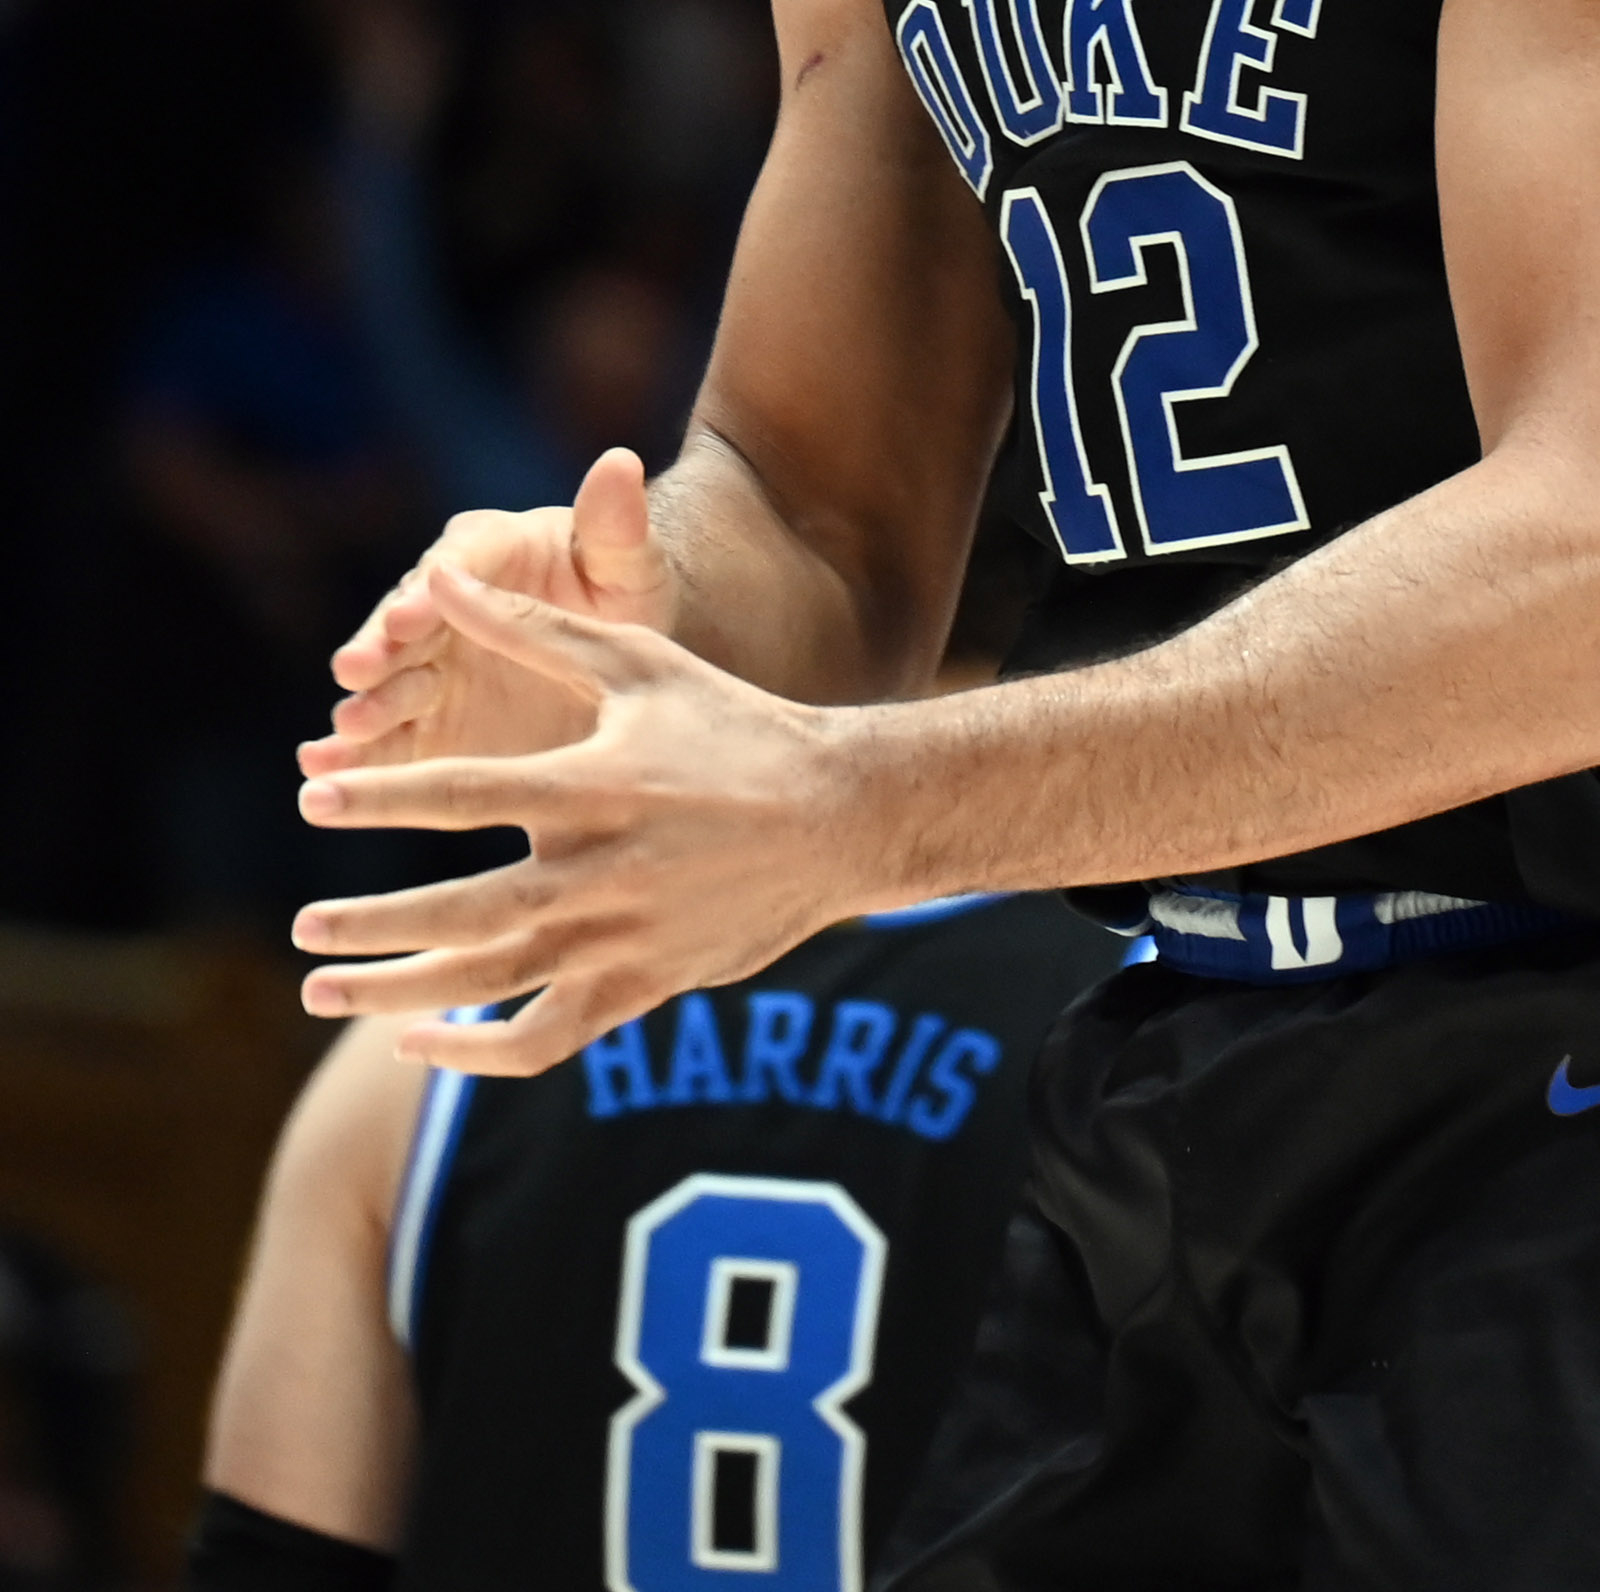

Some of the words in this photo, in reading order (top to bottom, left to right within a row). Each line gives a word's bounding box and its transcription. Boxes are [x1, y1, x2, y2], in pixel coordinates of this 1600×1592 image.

[1000, 160, 1312, 565] 12
[578, 988, 1002, 1144] HARRIS
[603, 1171, 890, 1592] 8
